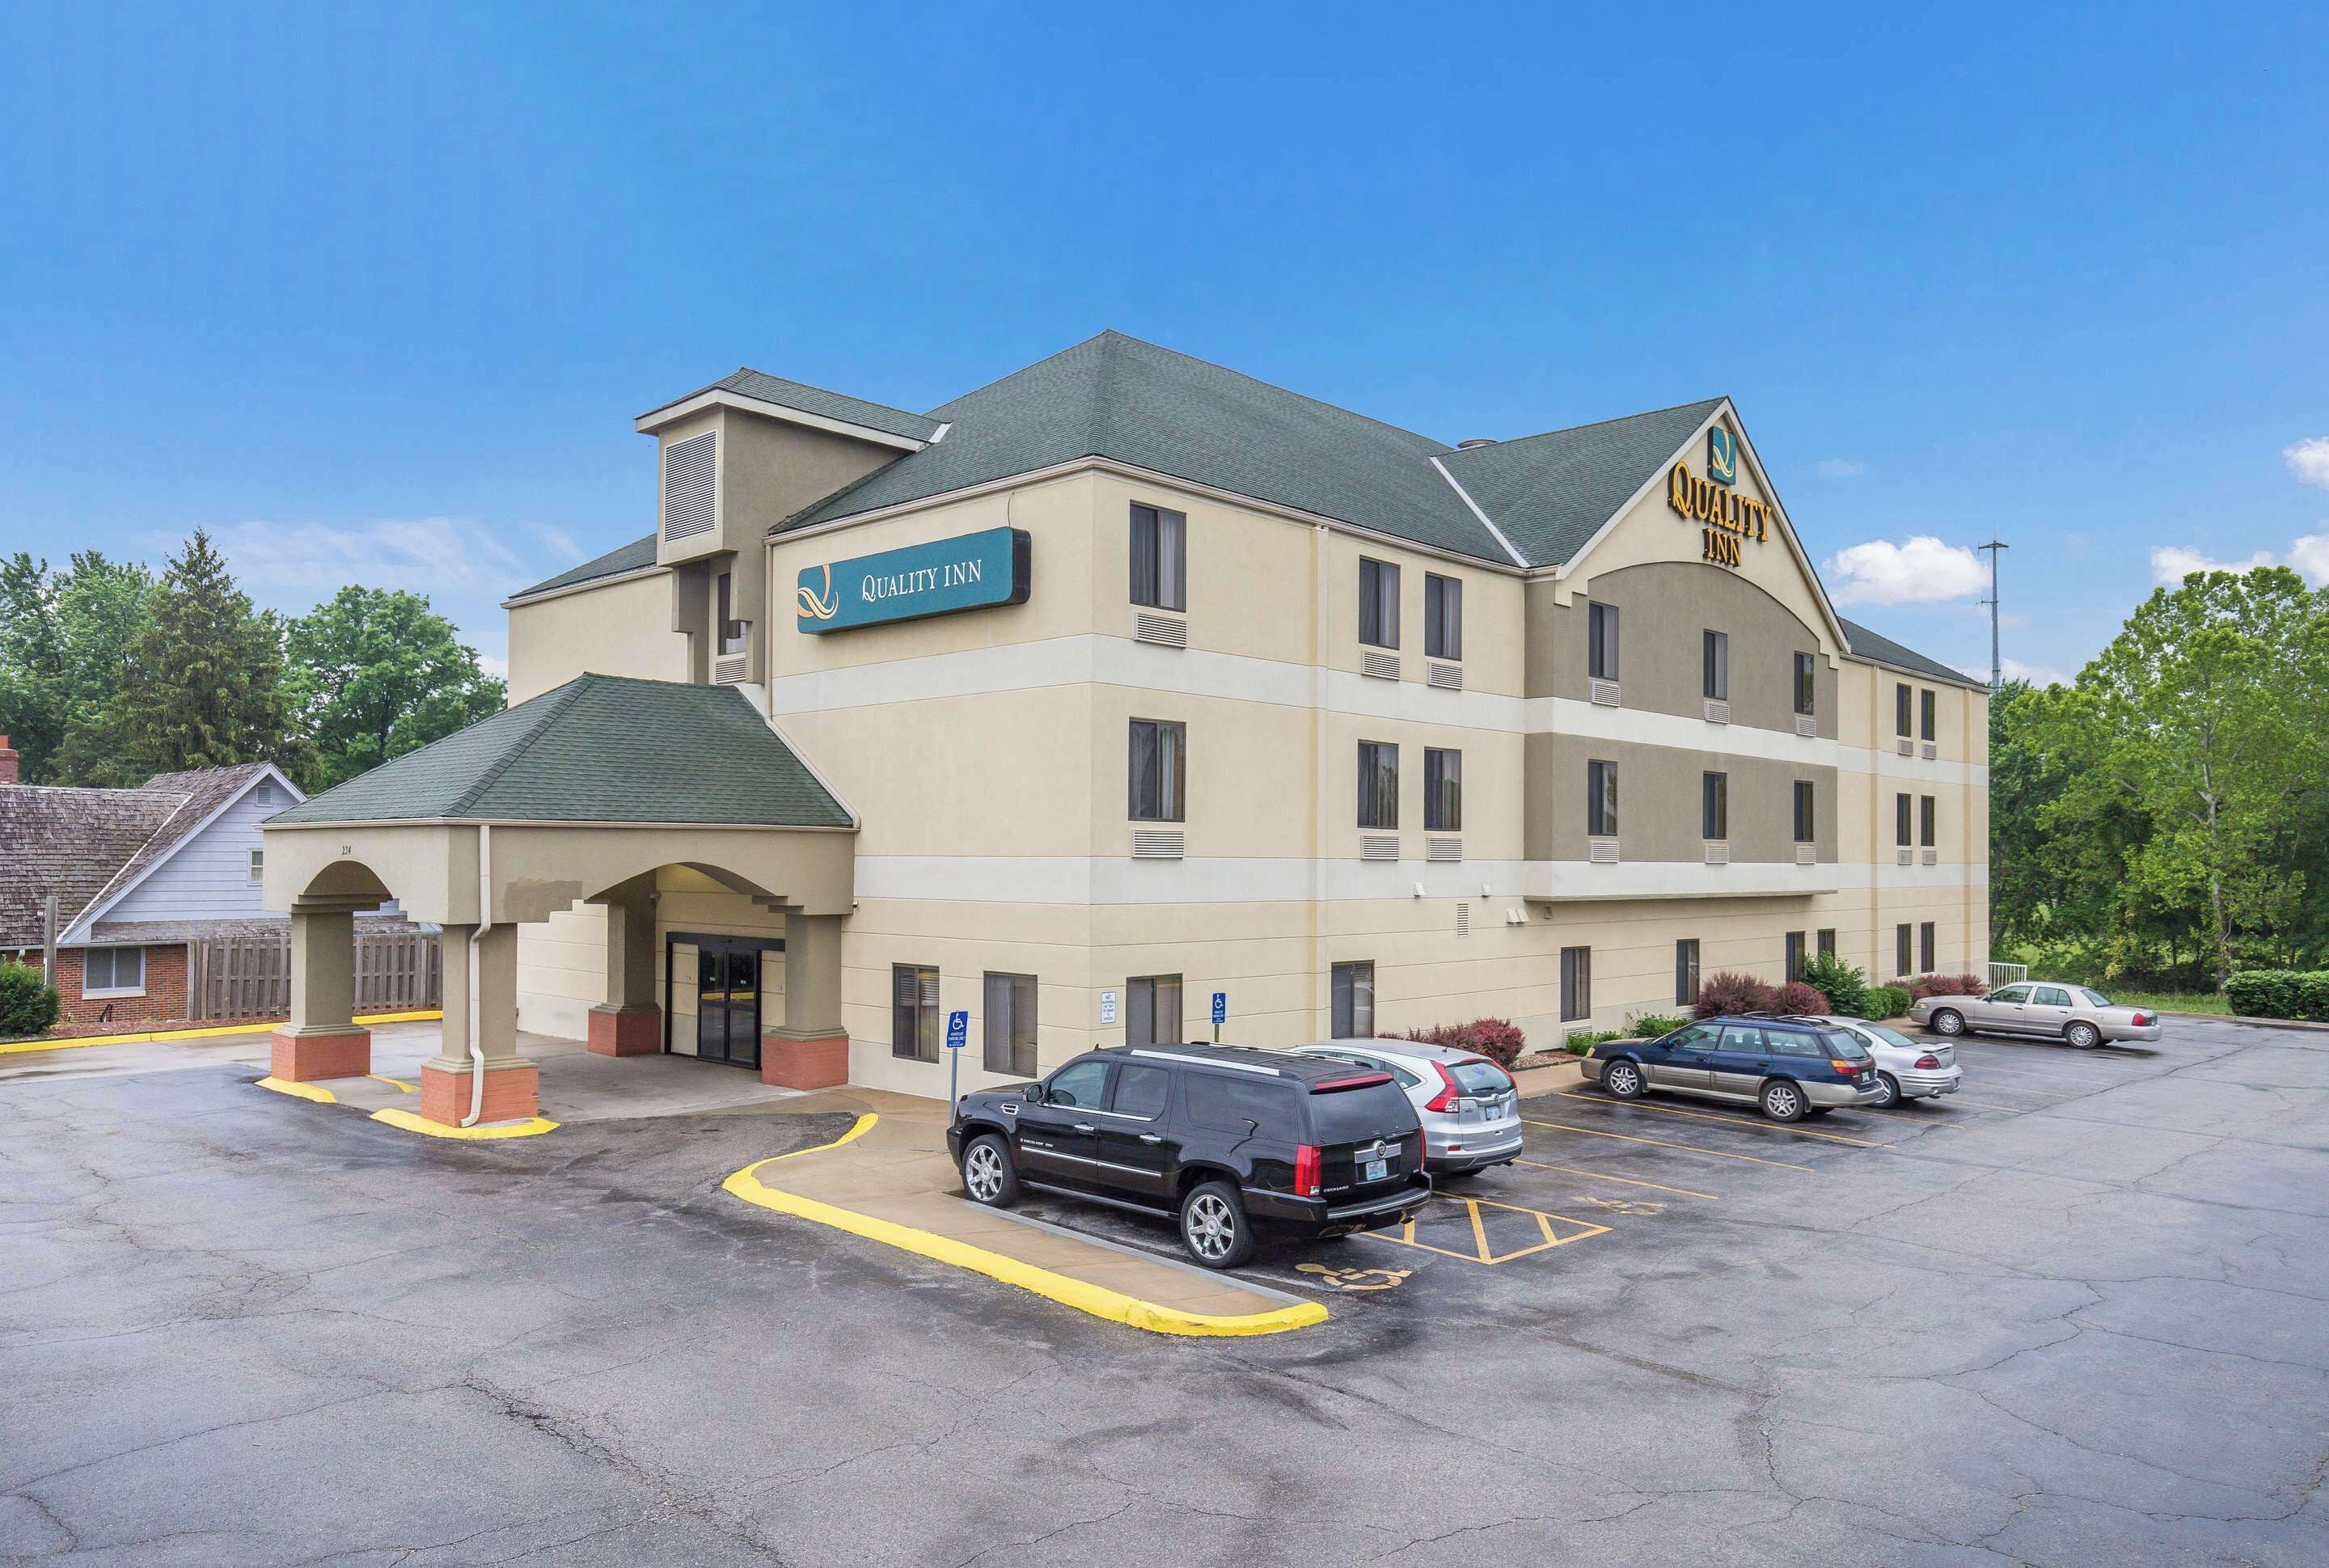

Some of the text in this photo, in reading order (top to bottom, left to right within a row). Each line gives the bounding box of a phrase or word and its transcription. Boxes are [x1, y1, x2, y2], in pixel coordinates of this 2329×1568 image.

[1668, 461, 1772, 543] QUALITY
[1702, 528, 1742, 567] INN
[862, 559, 983, 602] QUALITY INN
